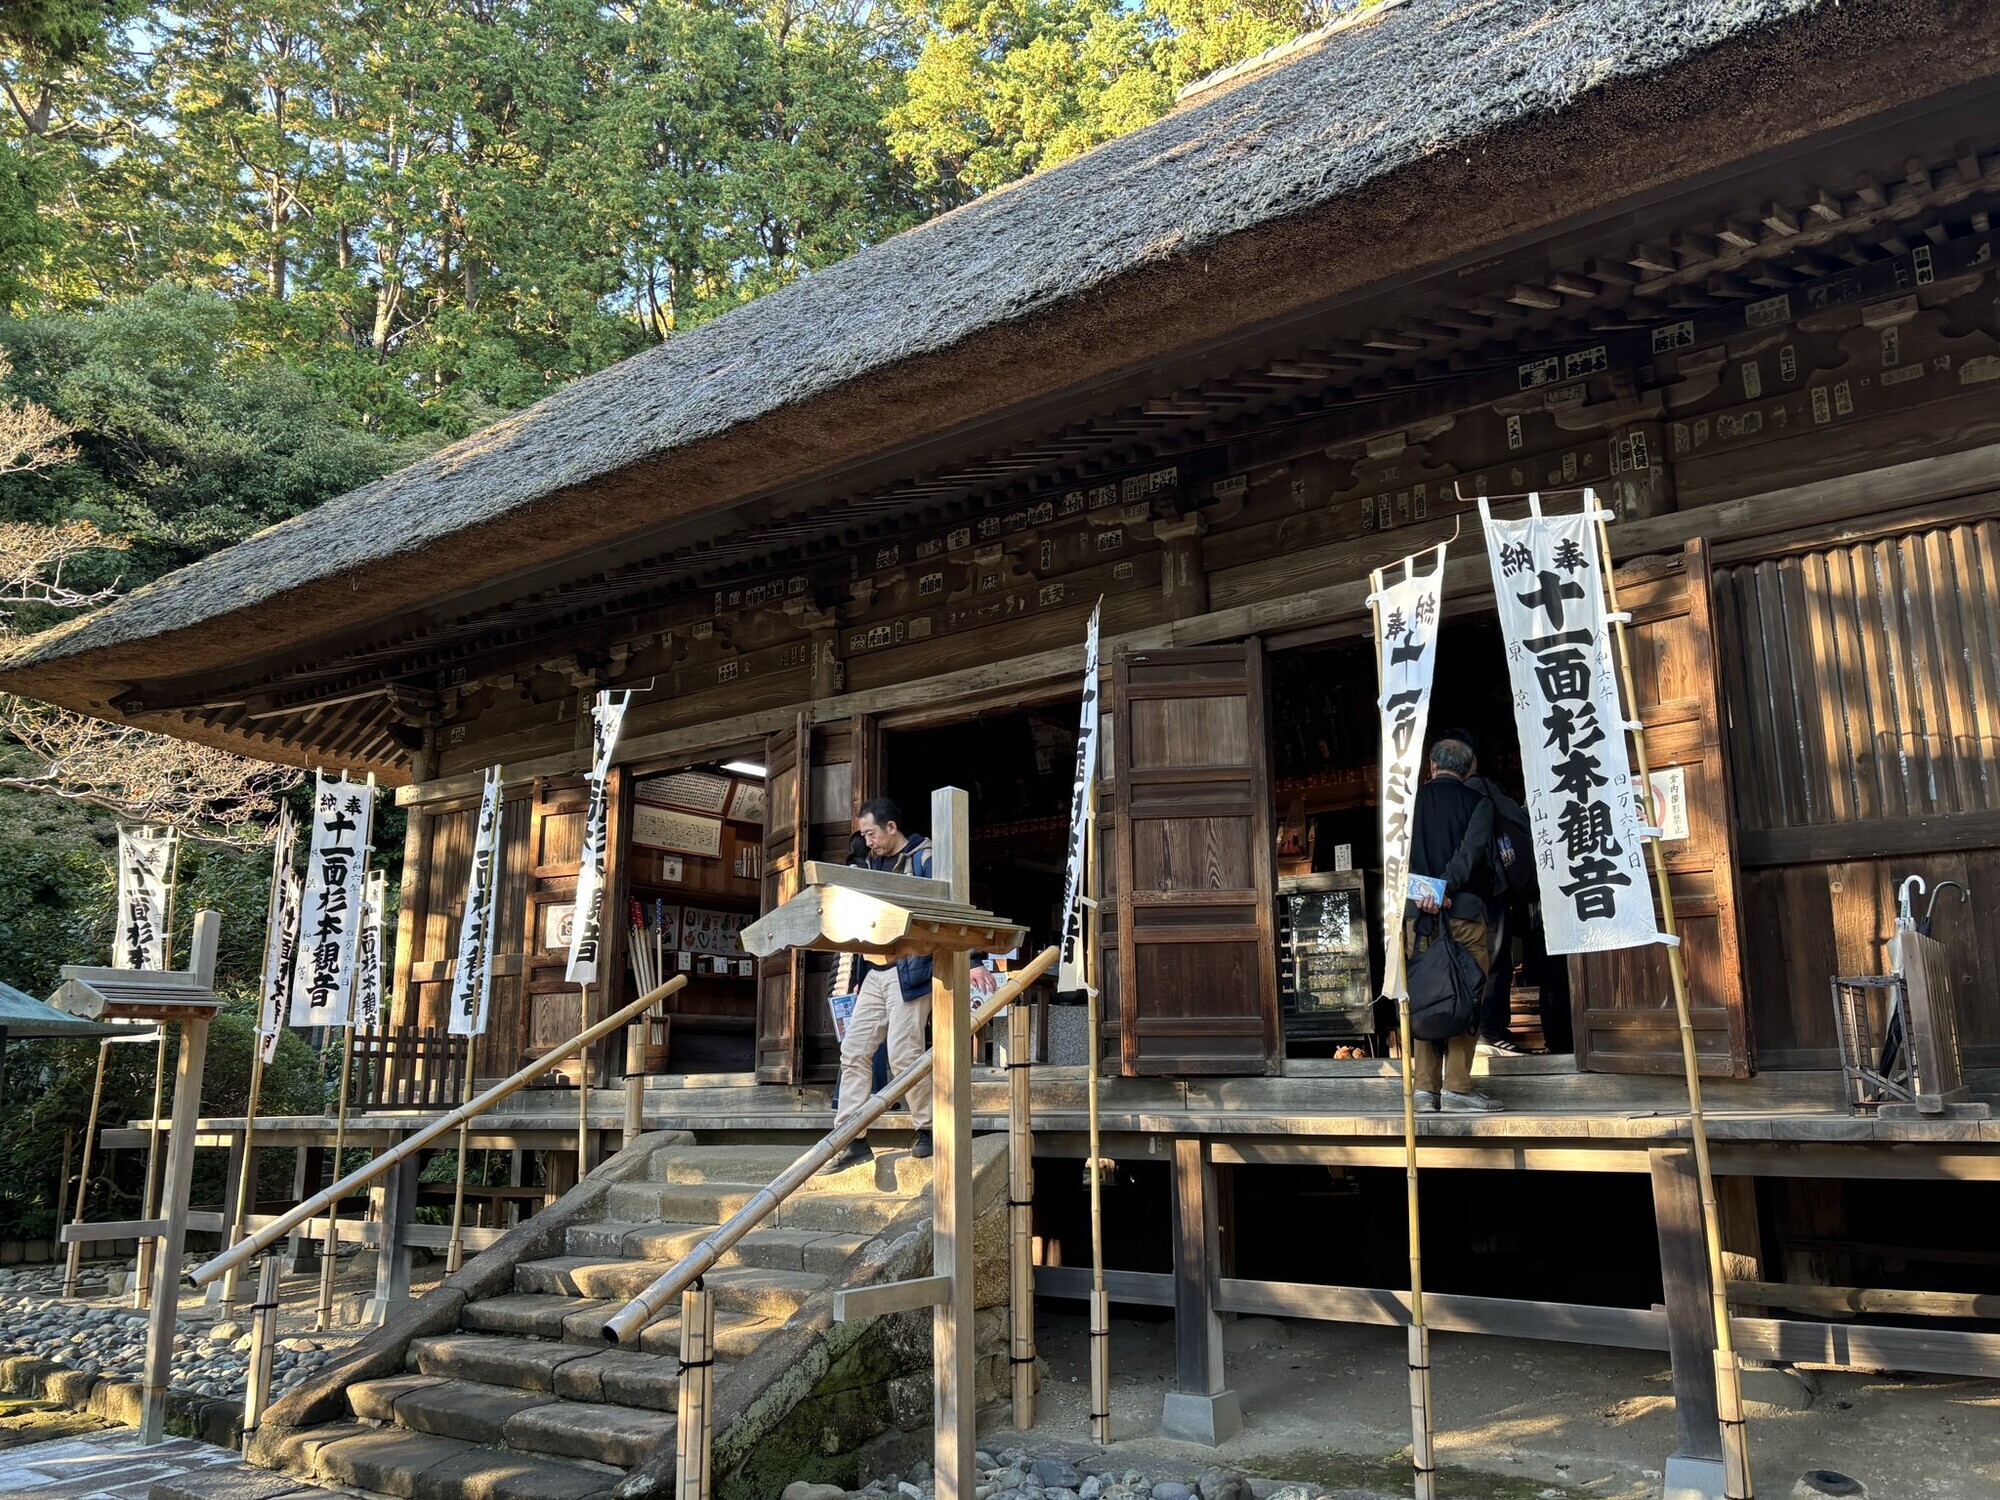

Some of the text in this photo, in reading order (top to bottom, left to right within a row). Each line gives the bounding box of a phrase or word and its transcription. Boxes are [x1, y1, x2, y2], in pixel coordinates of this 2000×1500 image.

[1516, 570, 1632, 922] 十一面杉本観音
[320, 793, 363, 816] 奉納
[1529, 789, 1556, 870] 戸山茂明
[1614, 773, 1642, 868] 四万六千日
[1669, 773, 1684, 834] 堂内撮影禁止
[306, 810, 357, 1009] 十一面杉本観音
[341, 929, 355, 987] 四万六千日
